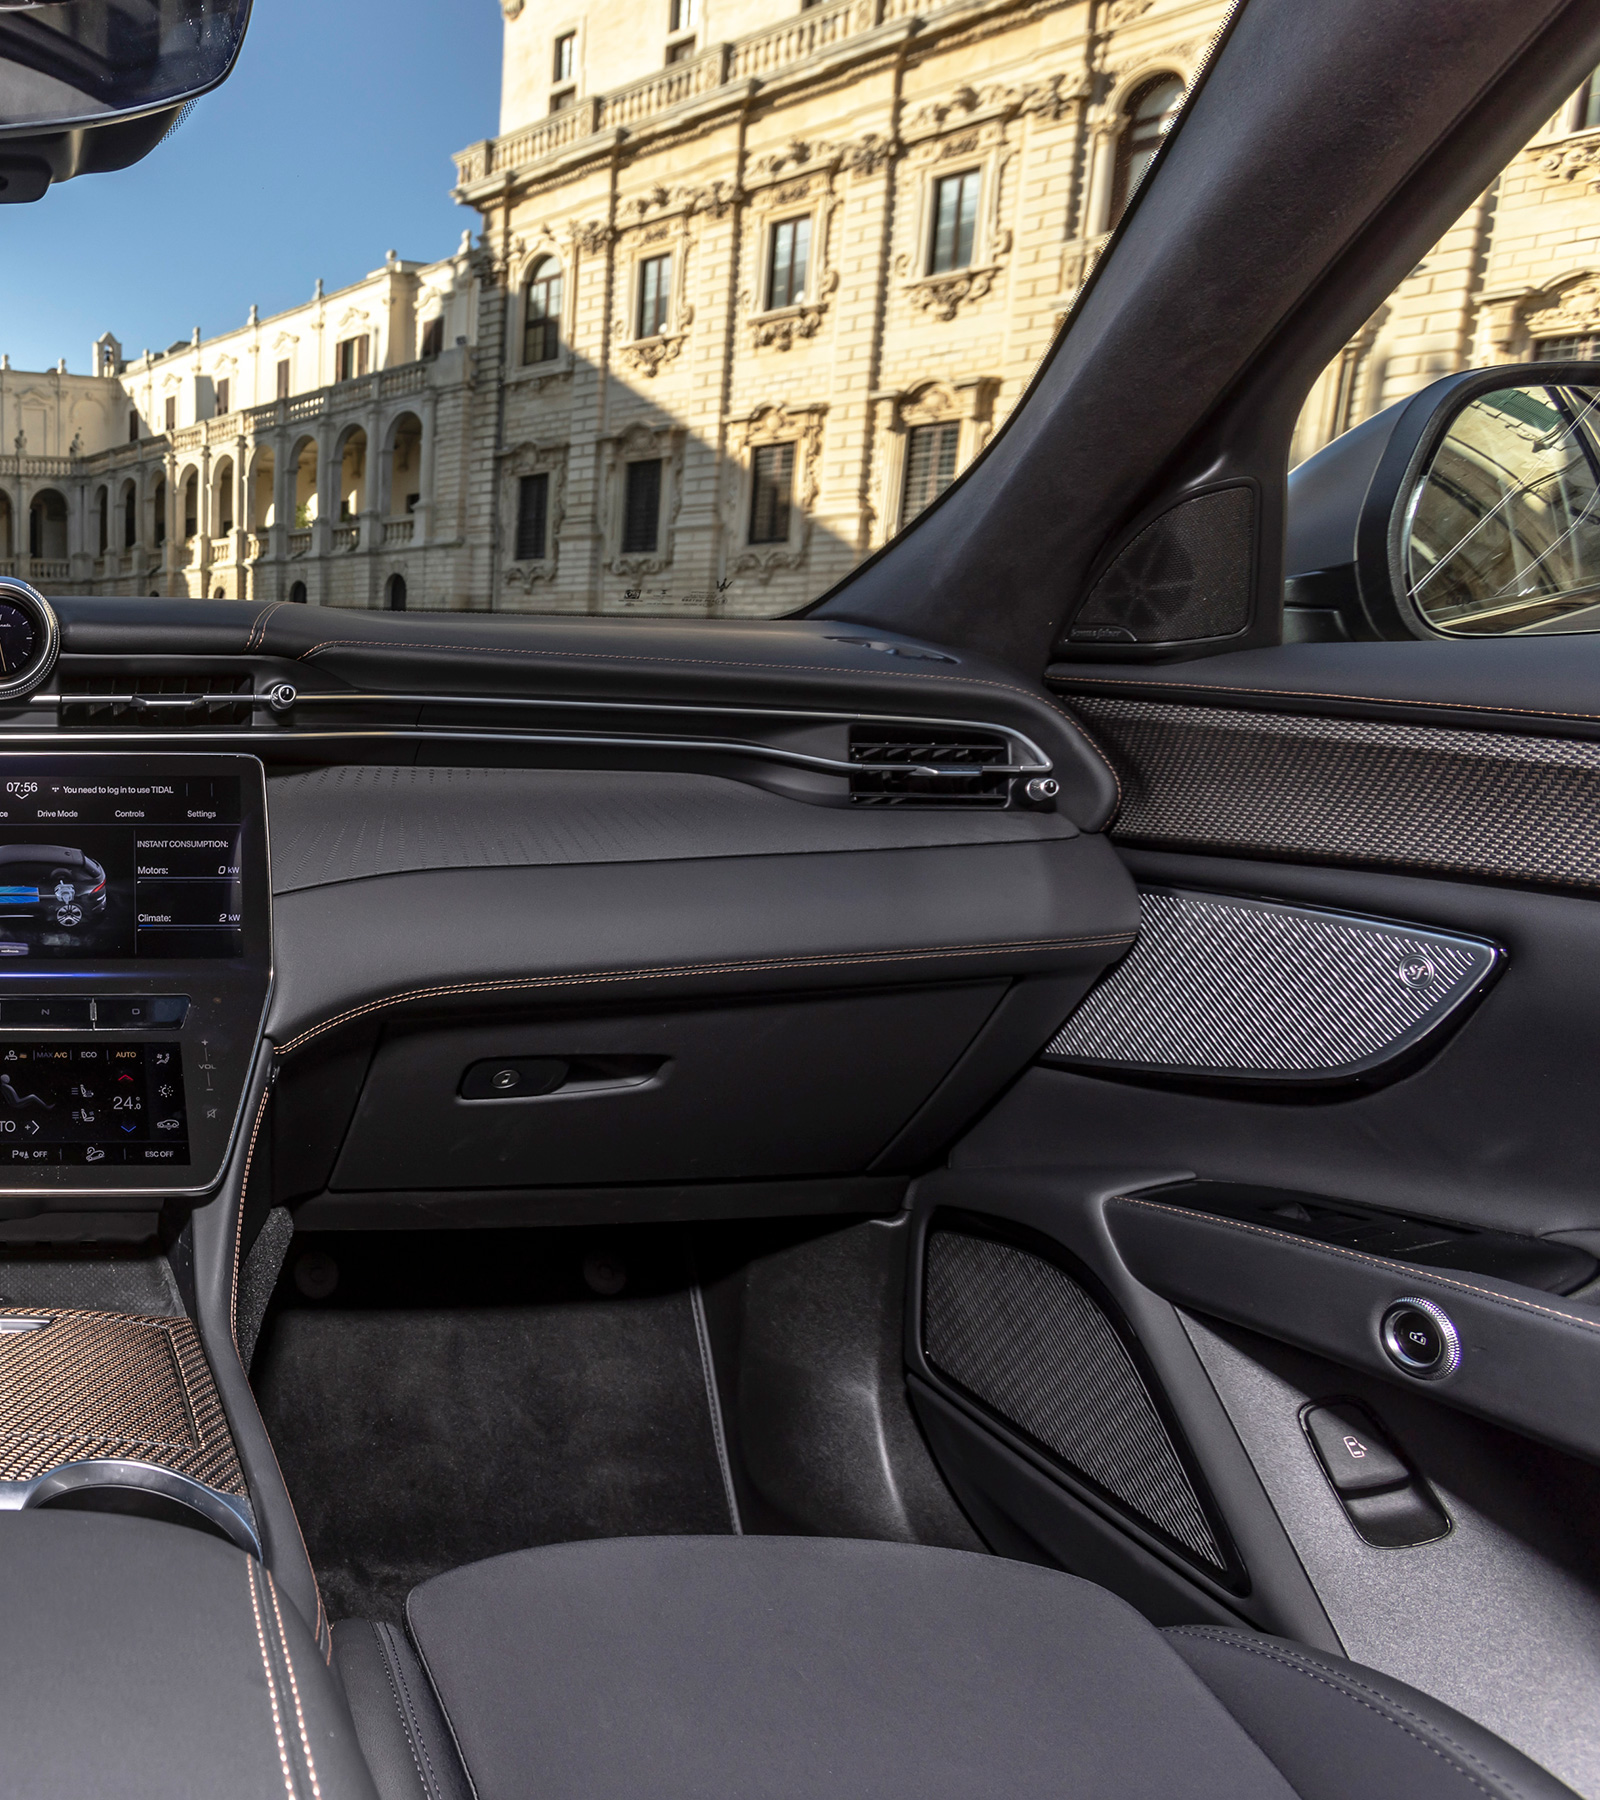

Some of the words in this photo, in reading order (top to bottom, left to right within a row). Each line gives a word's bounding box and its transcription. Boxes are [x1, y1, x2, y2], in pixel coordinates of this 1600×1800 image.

[6, 782, 38, 793] 07:56
[63, 786, 77, 794] You
[78, 786, 97, 794] need
[98, 786, 107, 794] to
[107, 786, 119, 796] log
[120, 786, 128, 794] in
[128, 786, 136, 794] to
[151, 786, 174, 794] TIDAL
[37, 810, 56, 818] Drive
[57, 810, 79, 818] Mode
[115, 810, 145, 818] Controls
[187, 810, 216, 820] Settings
[137, 840, 168, 848] INSTANT
[169, 840, 229, 848] CONSUMPTION:
[137, 866, 169, 874] Motors:
[217, 865, 226, 875] 0
[137, 913, 171, 922] Climate:
[219, 913, 227, 923] 2
[37, 1051, 53, 1059] MAX
[54, 1051, 68, 1059] A/C
[81, 1051, 97, 1059] ECO
[116, 1051, 137, 1059] AUTO
[144, 1150, 159, 1158] ESC
